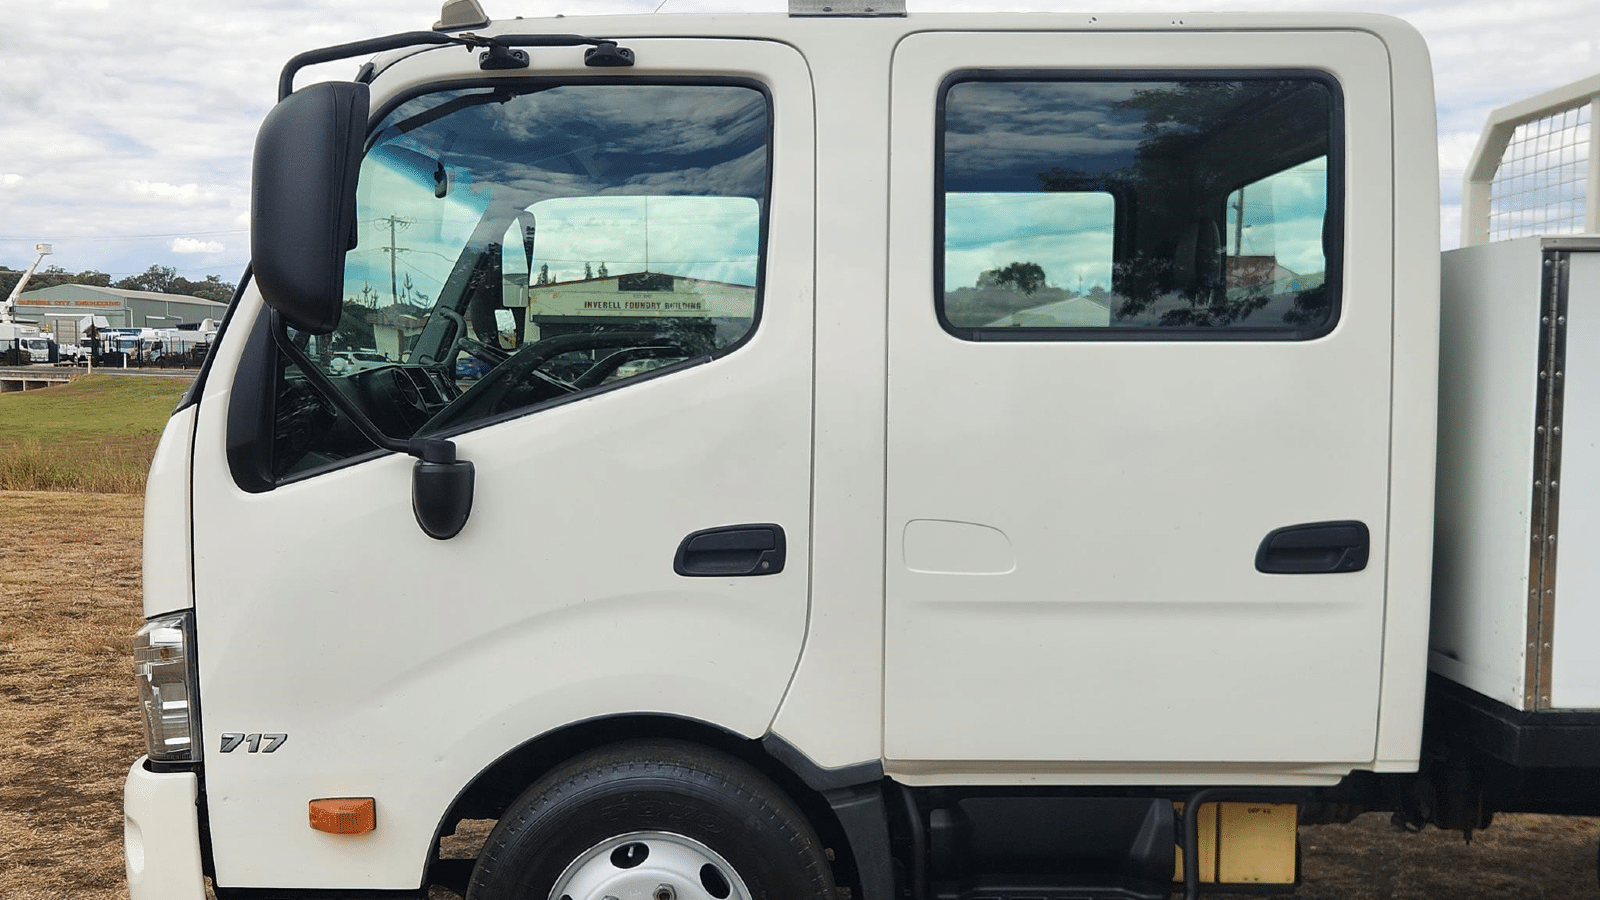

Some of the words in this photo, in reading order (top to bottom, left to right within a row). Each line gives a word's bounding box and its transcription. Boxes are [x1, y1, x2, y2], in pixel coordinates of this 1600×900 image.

[584, 301, 621, 309] INVERELL
[625, 301, 662, 309] FOUNDRY
[665, 302, 702, 310] BUILDING
[219, 732, 288, 753] 717
